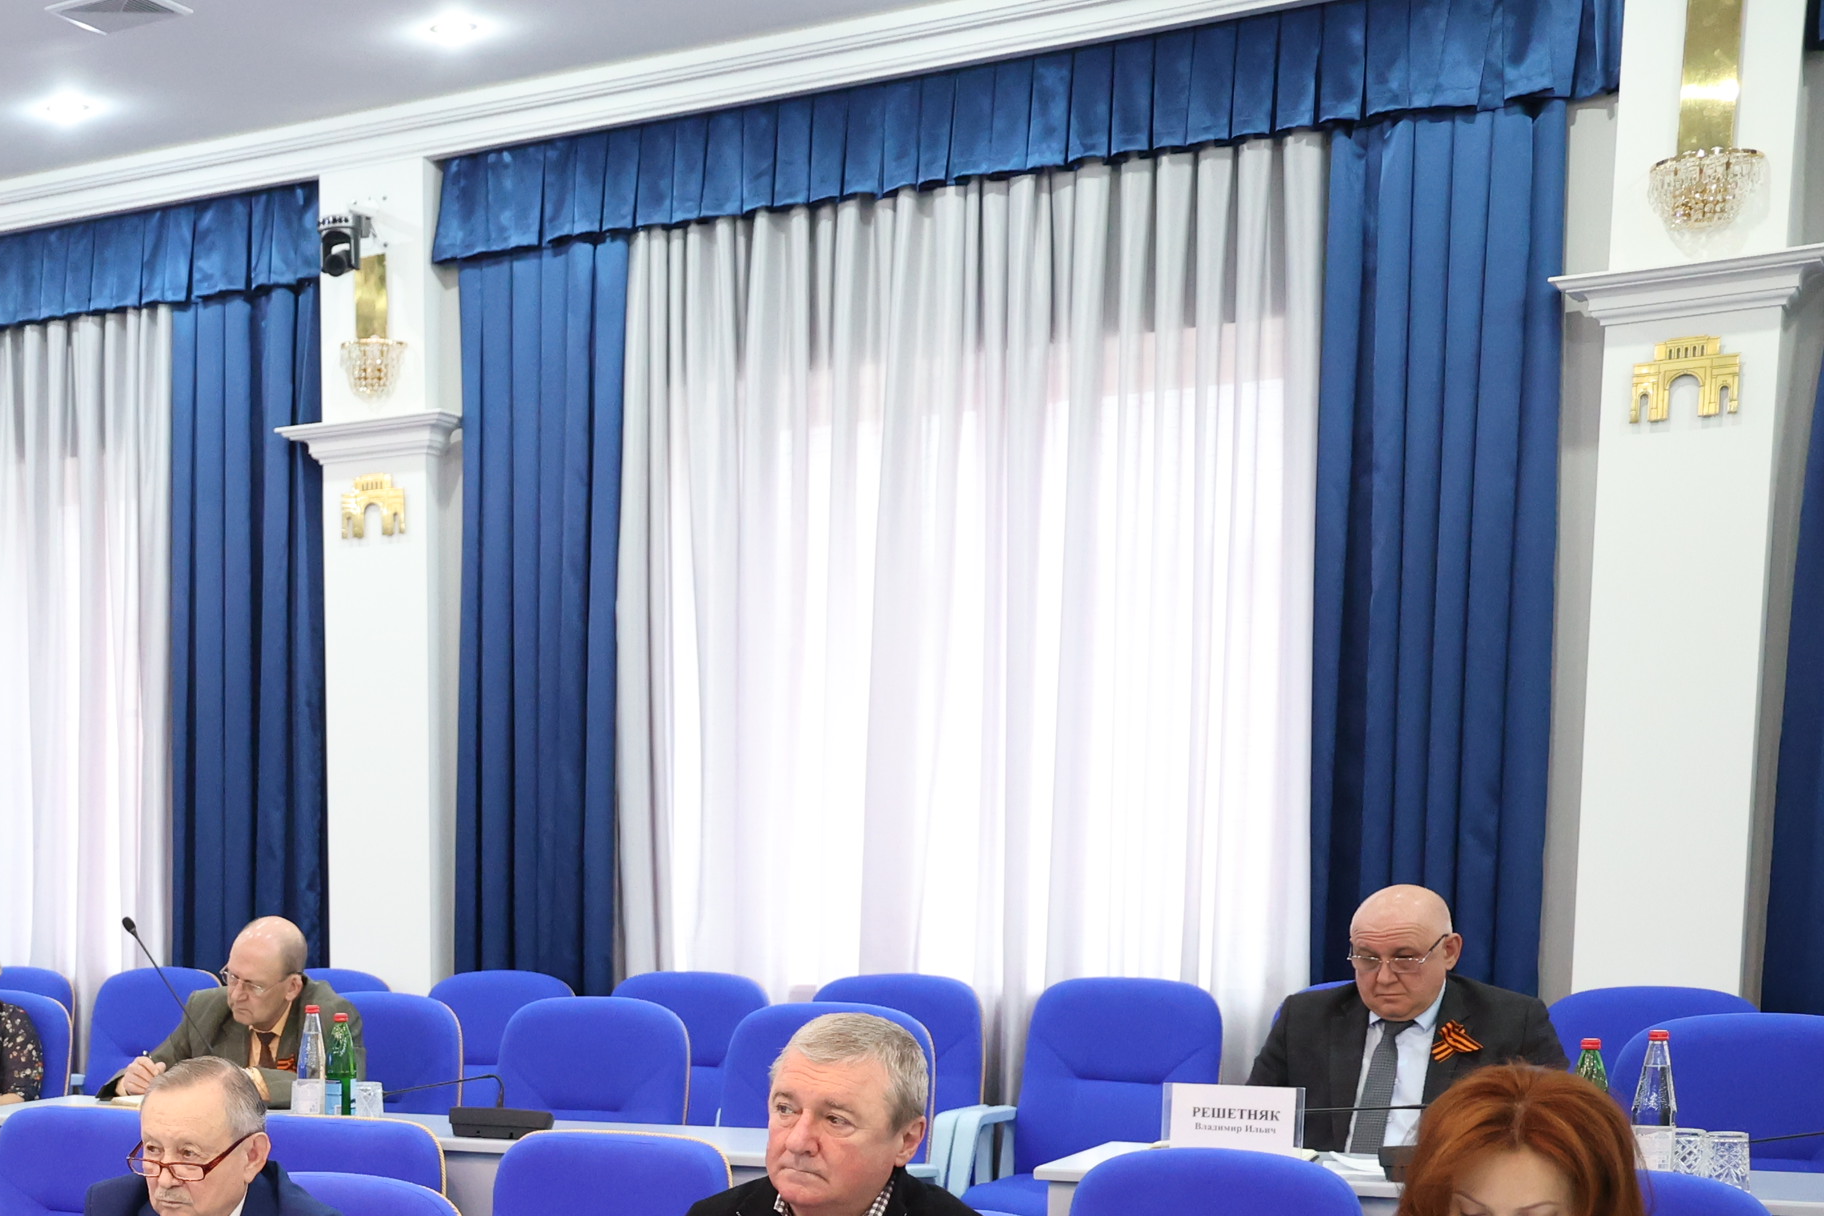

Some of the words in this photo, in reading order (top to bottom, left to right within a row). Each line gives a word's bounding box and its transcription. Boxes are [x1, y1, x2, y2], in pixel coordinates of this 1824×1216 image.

[1192, 1106, 1281, 1122] РЕШЕТНЯК
[1194, 1122, 1242, 1134] Владимир
[1245, 1125, 1276, 1134] Ильич
